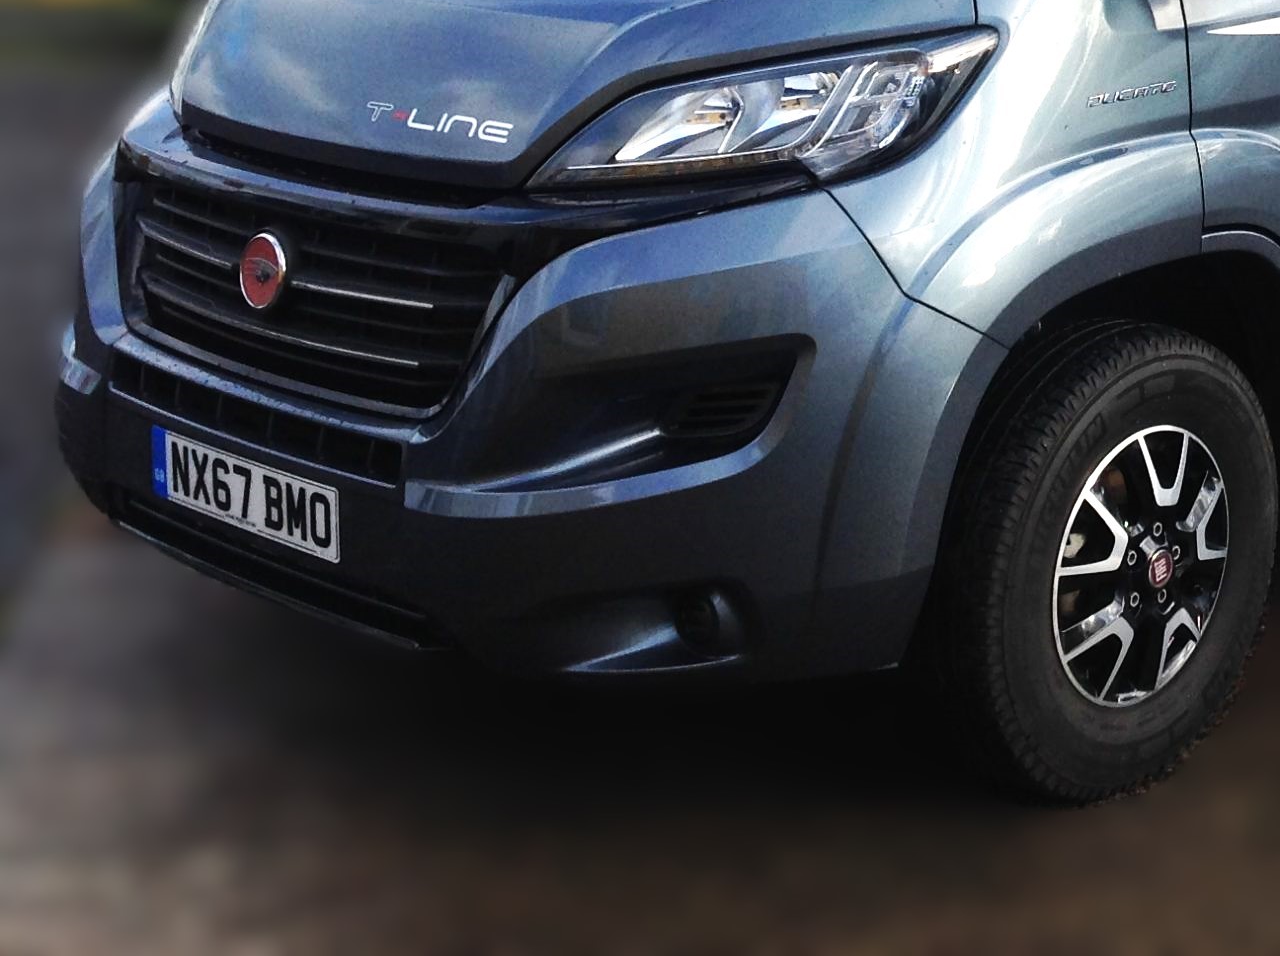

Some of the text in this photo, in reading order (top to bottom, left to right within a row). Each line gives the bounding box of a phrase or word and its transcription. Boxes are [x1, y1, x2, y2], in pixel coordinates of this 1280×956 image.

[1086, 81, 1177, 108] DUCATO
[366, 100, 514, 144] T-LINE
[171, 441, 332, 549] NX67 BMO
